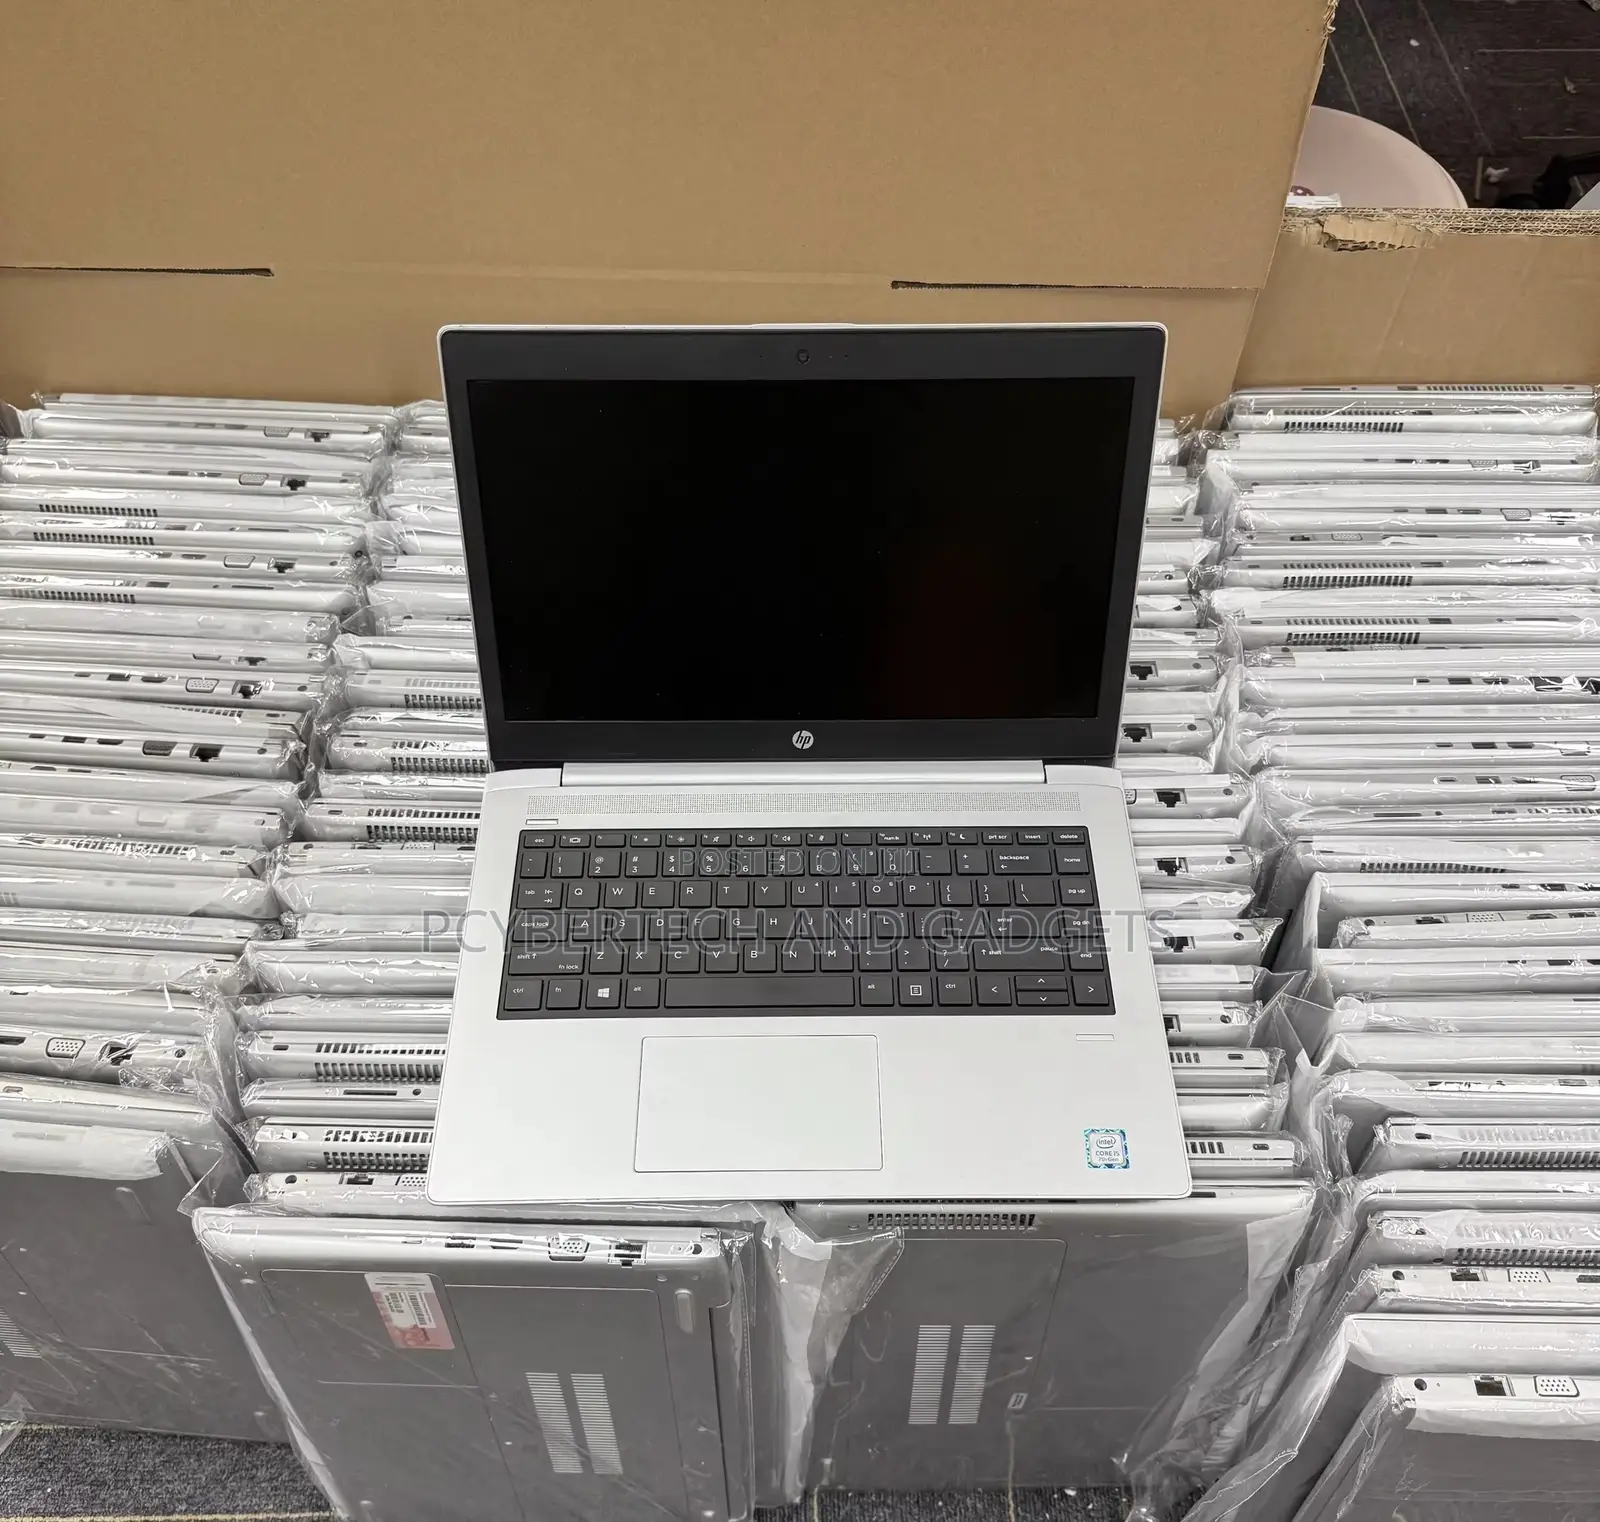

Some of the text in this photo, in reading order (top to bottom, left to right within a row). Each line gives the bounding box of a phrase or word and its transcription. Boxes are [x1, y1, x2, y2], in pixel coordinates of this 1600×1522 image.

[793, 730, 813, 749] hp
[574, 888, 583, 896] Q
[649, 887, 656, 895] E
[723, 886, 730, 894] T
[761, 886, 769, 894] Y
[872, 885, 881, 893] O
[580, 920, 589, 928] A
[732, 918, 740, 926] G
[846, 917, 853, 925] K
[636, 951, 643, 959] X
[674, 951, 682, 959] C
[712, 951, 720, 959] V
